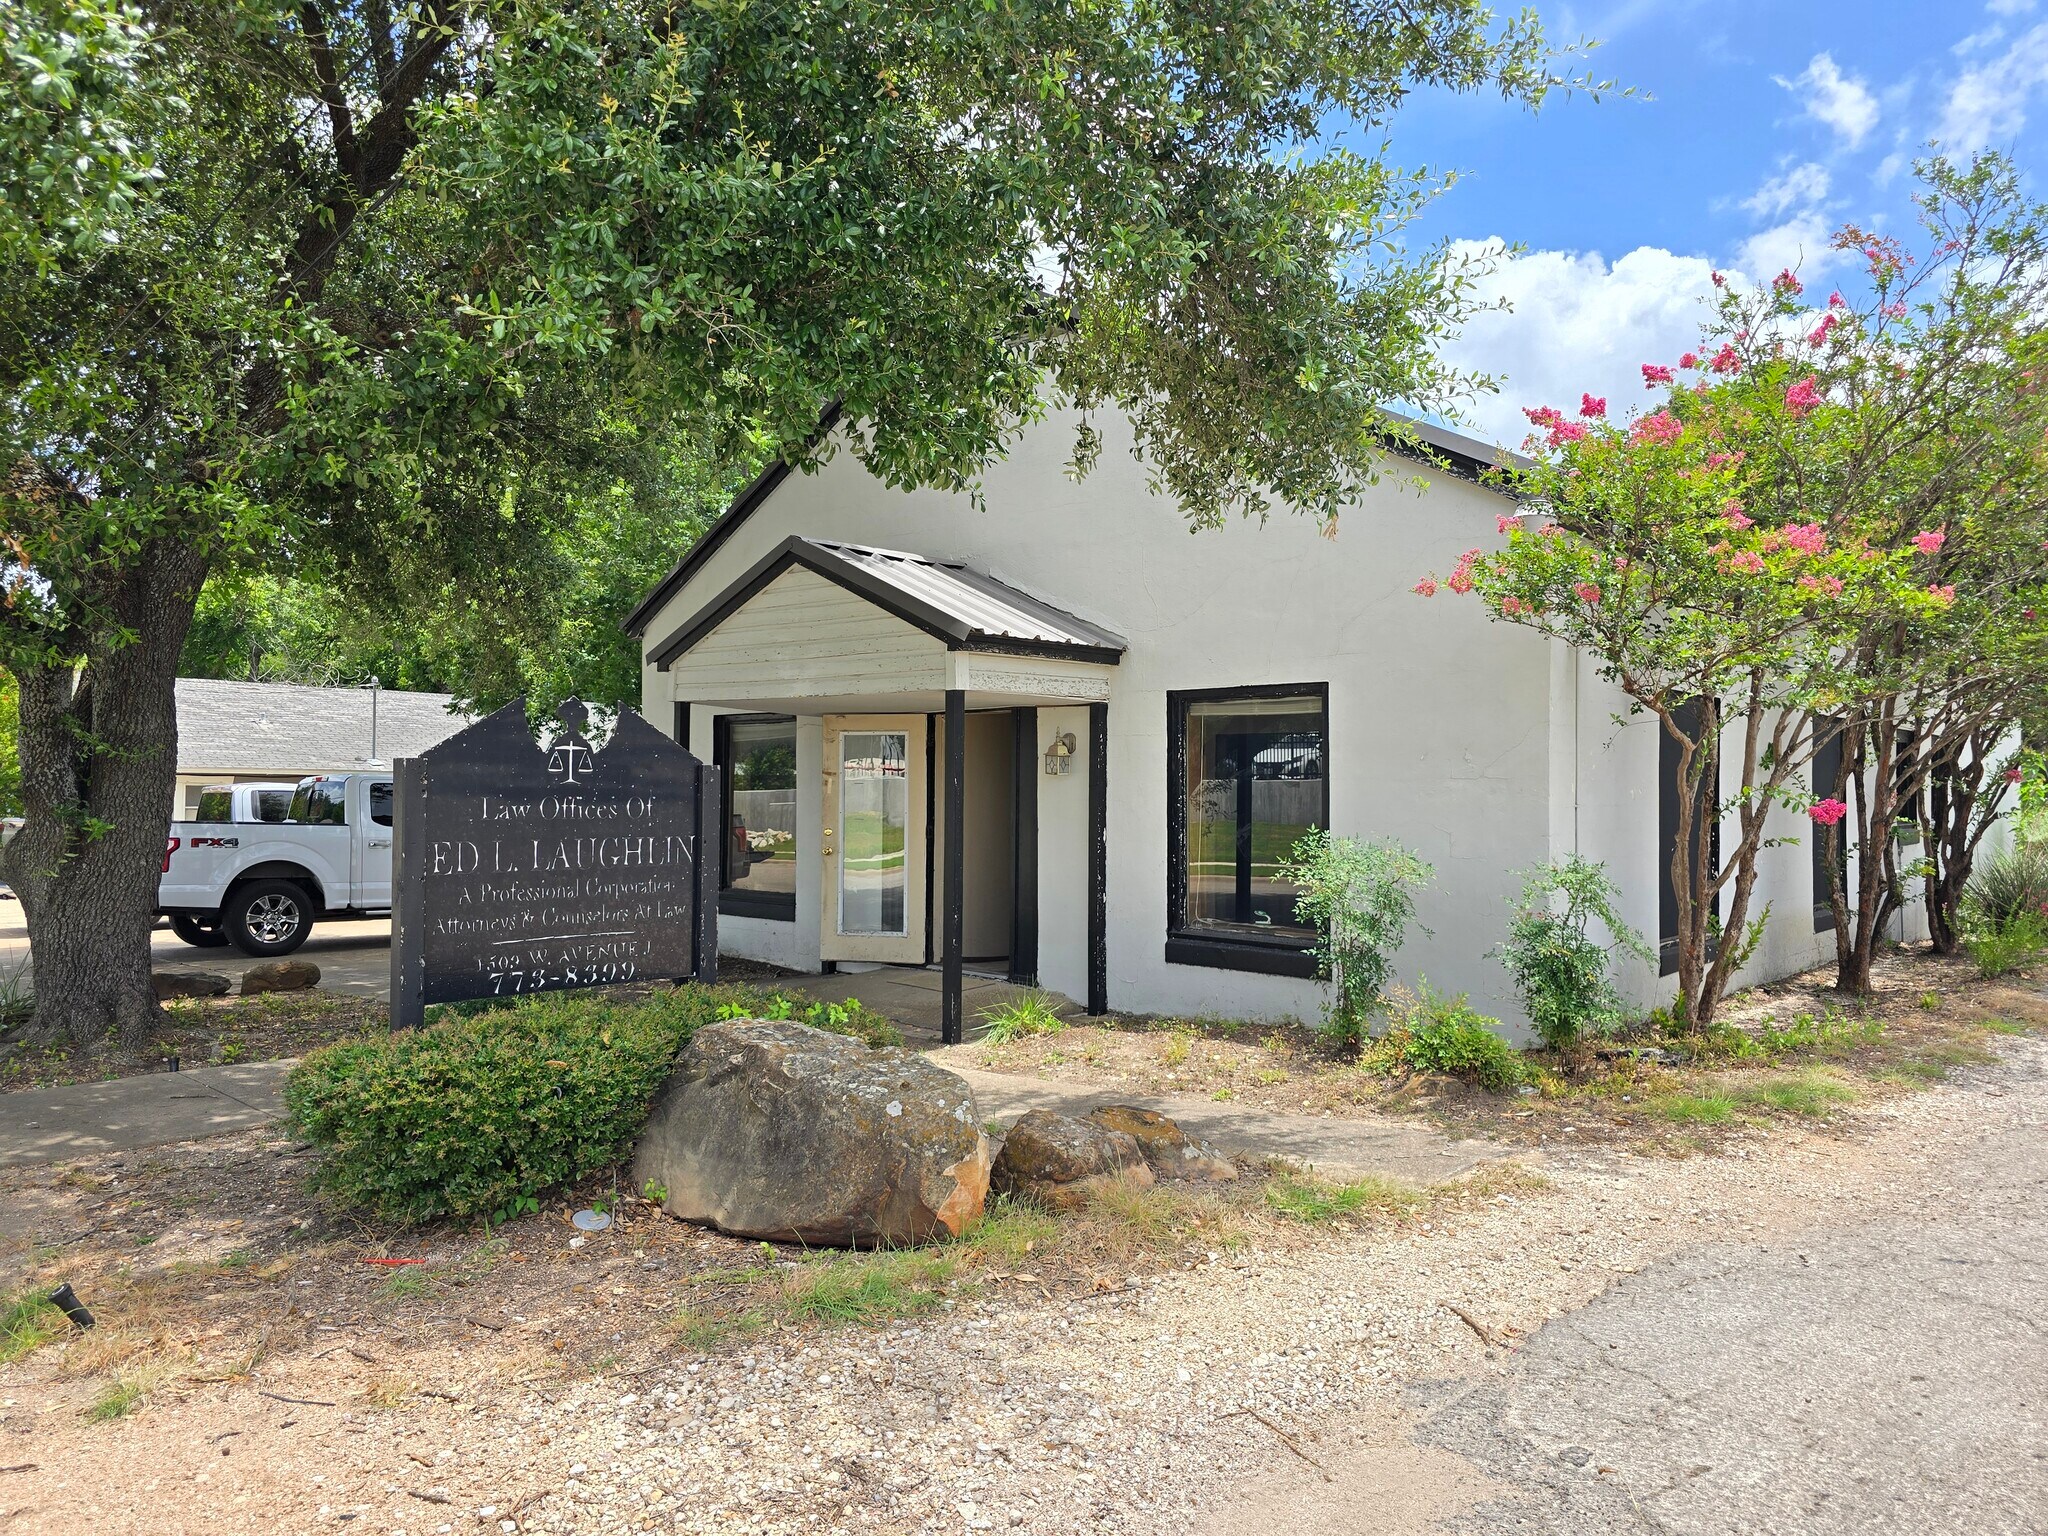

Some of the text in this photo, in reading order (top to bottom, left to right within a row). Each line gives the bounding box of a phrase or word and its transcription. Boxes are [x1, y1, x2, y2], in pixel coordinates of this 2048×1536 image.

[480, 795, 656, 820] Law Offices Of
[190, 837, 239, 848] FX4
[432, 834, 695, 875] ED L. LAUGHLIN
[459, 877, 676, 905] A Professional Corporation
[433, 900, 686, 936] Attorneys & Counselors At Law
[527, 948, 552, 966] W.
[559, 940, 638, 964] AVENUE
